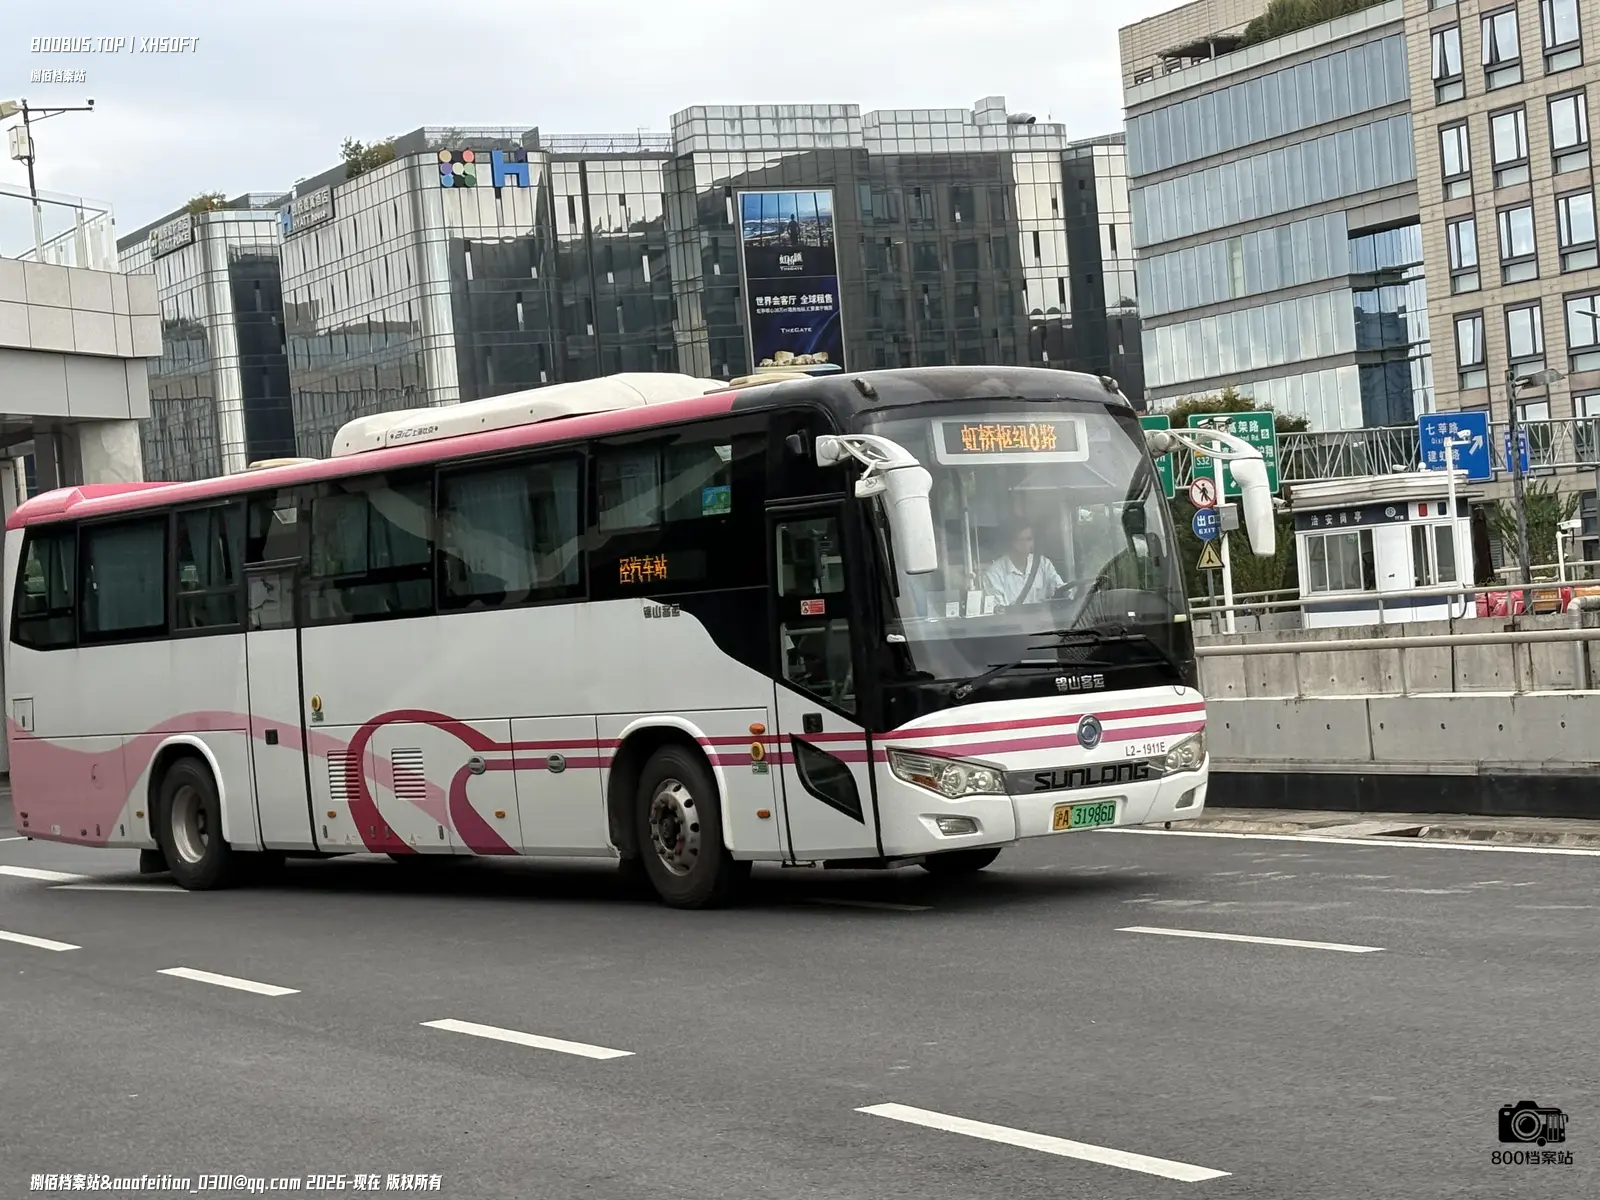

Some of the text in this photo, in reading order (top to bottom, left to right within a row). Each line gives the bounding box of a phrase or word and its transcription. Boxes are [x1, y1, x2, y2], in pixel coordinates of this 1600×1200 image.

[755, 294, 833, 306] 世界会客厅 全球租售
[961, 424, 1057, 451] 虹桥枢纽8路
[1196, 457, 1210, 466] S32
[1197, 514, 1217, 527] 出口
[1199, 527, 1216, 535] EXIT
[1125, 742, 1166, 757] L2-1911E
[1034, 761, 1150, 791] SUNLONG
